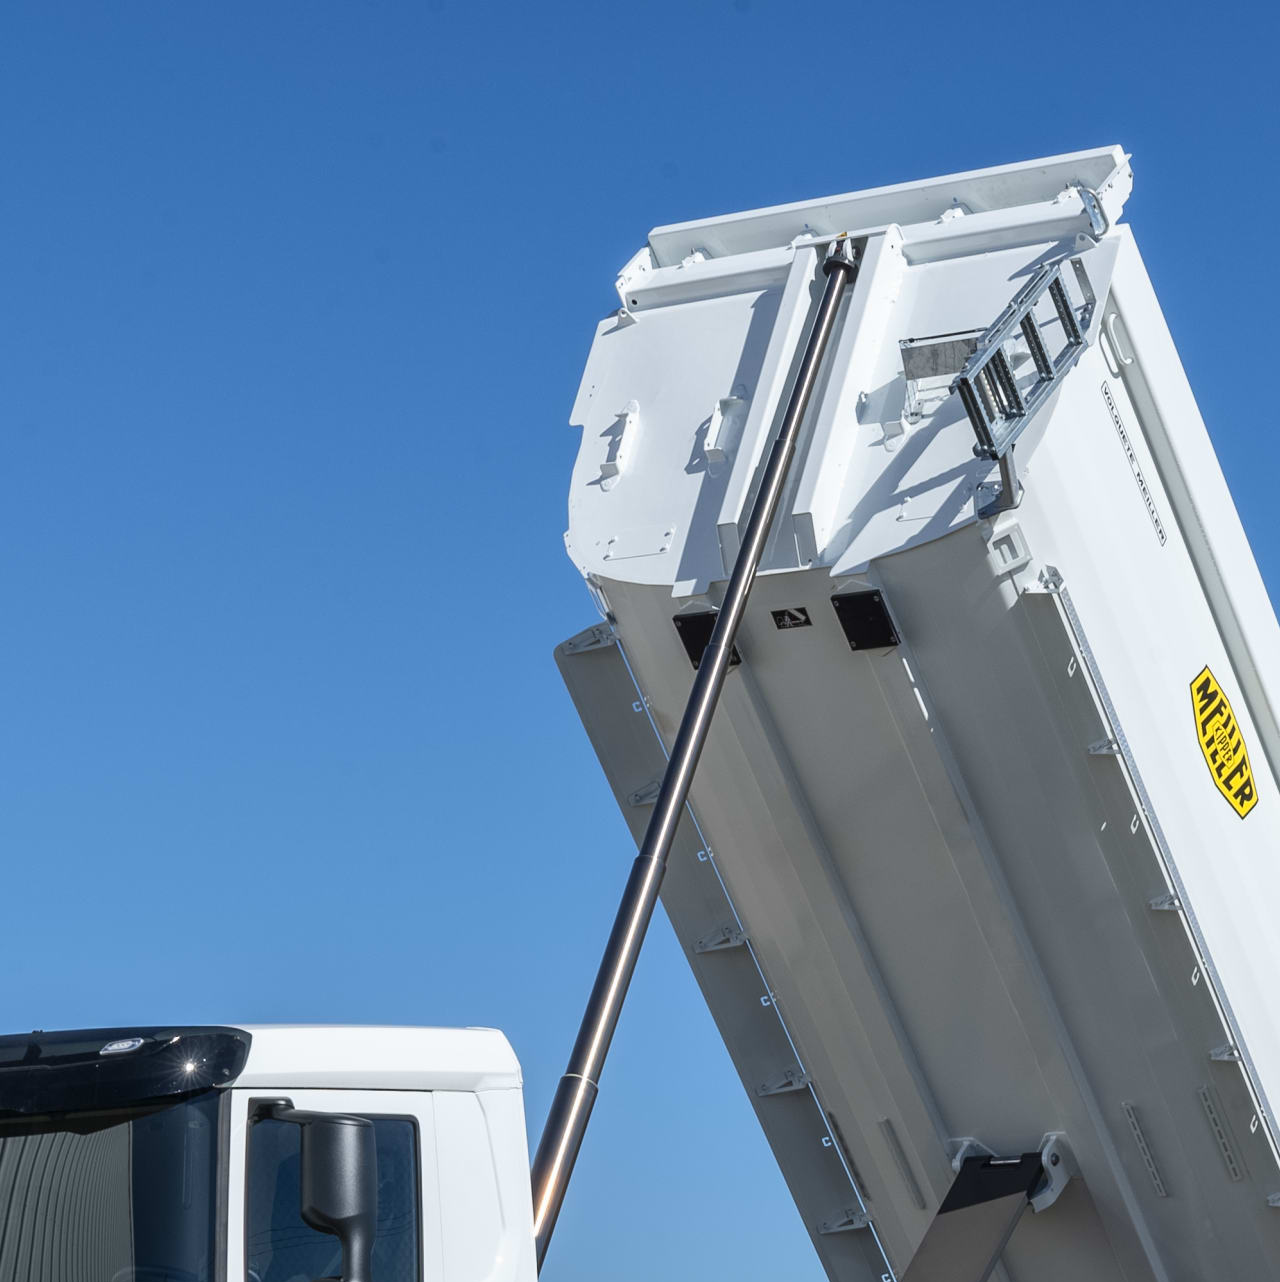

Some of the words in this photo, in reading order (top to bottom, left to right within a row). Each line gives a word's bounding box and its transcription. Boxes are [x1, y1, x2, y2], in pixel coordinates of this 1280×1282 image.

[1103, 385, 1136, 465] VOLQUETE
[1136, 471, 1165, 541] MEILLER
[1196, 676, 1254, 808] MEILLER
[1214, 725, 1233, 764] KIPPER
